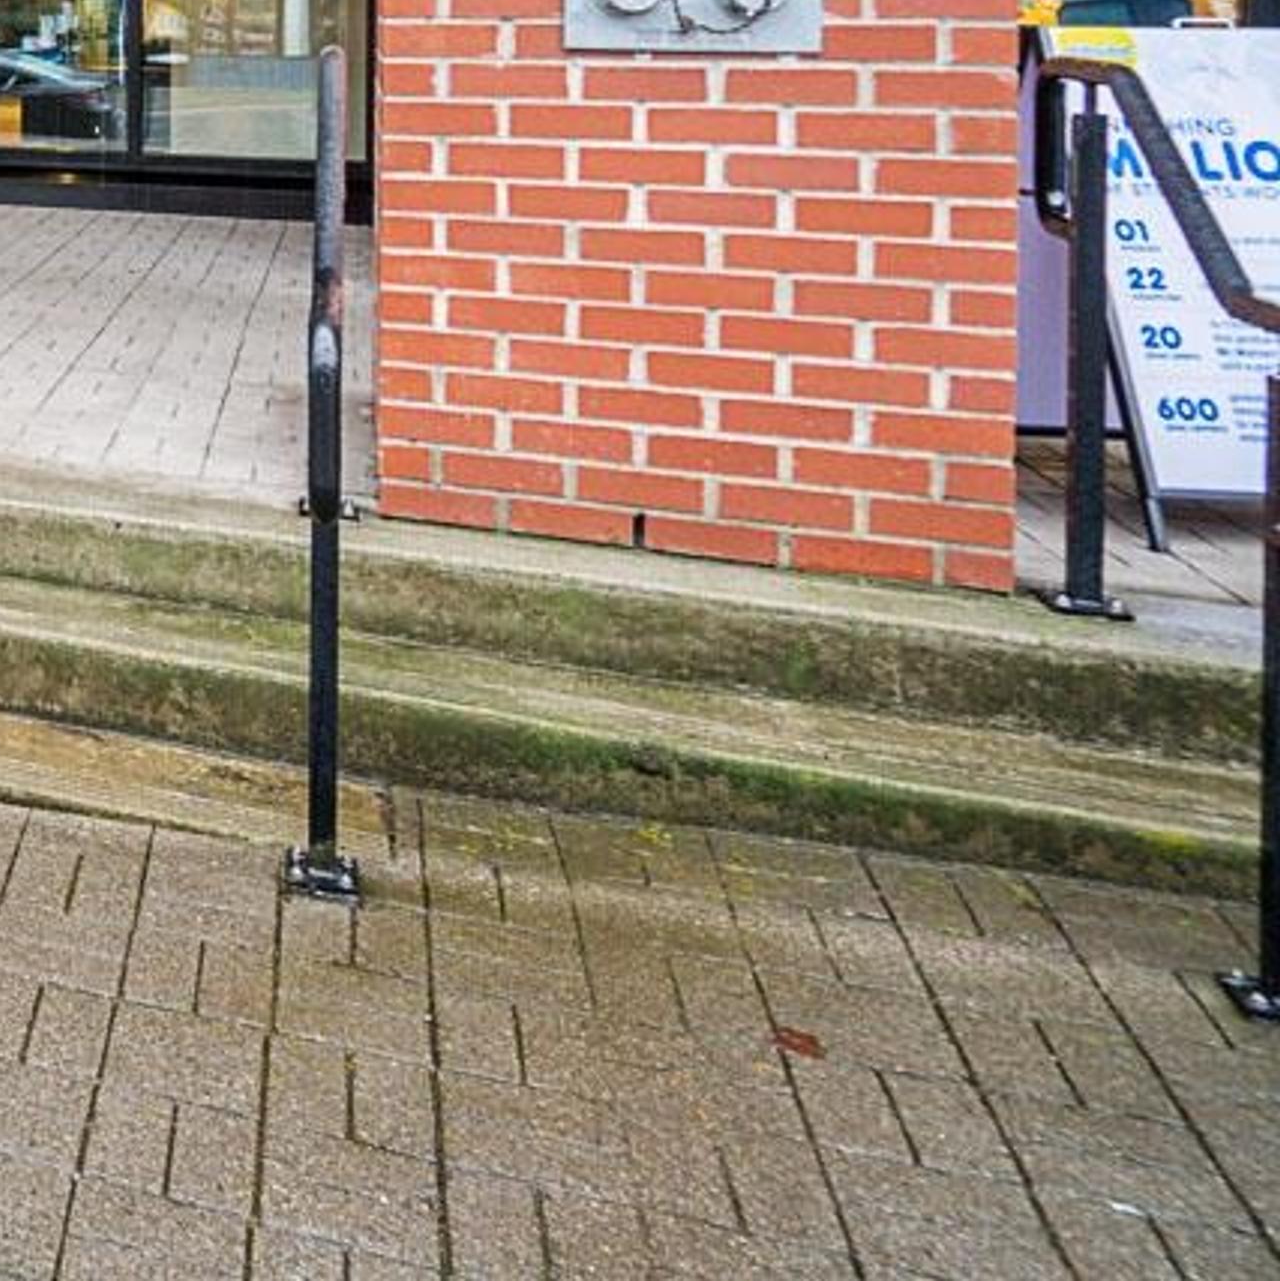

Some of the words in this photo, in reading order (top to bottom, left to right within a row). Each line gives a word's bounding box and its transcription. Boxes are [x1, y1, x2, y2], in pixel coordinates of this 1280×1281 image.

[1114, 219, 1150, 242] 01
[1126, 267, 1169, 290] 22
[1140, 325, 1183, 350] 20
[1158, 398, 1220, 422] 600
